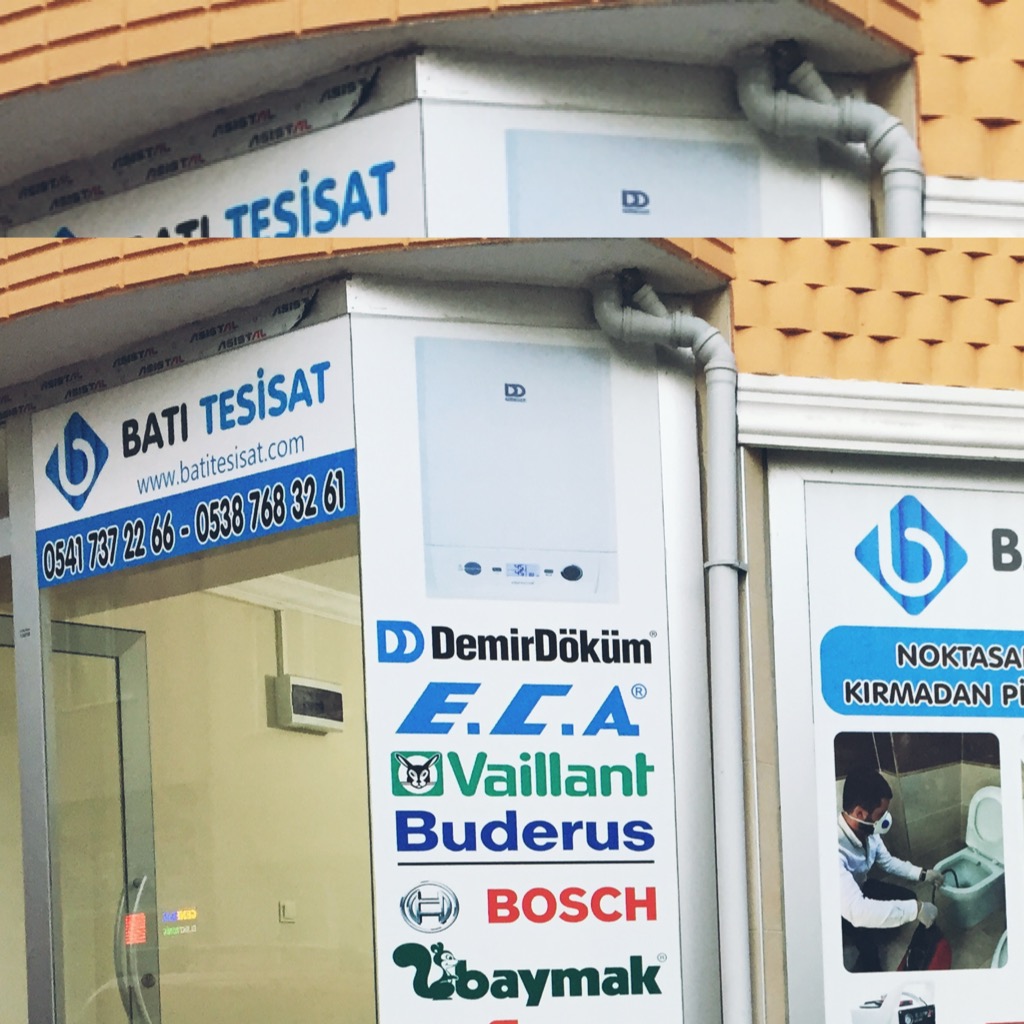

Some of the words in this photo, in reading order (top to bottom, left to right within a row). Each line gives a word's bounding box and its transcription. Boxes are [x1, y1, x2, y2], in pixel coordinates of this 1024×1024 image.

[122, 402, 188, 458] BATI
[199, 361, 331, 435] TESİSAT
[137, 434, 305, 494] www.batitesisat.com
[43, 537, 84, 581] 0541
[88, 523, 119, 571] 737
[122, 519, 147, 561] 22
[151, 510, 174, 554] 66
[195, 494, 244, 545] 0538
[249, 484, 286, 531] 768
[291, 475, 317, 520] 32
[323, 467, 346, 513] 61
[431, 626, 653, 664] DemirDöküm
[843, 678, 993, 708] KIRMADAN
[447, 751, 655, 797] Vaillant
[395, 810, 656, 852] Buderus
[487, 887, 658, 924] BOSCH
[455, 956, 663, 1007] baymak
